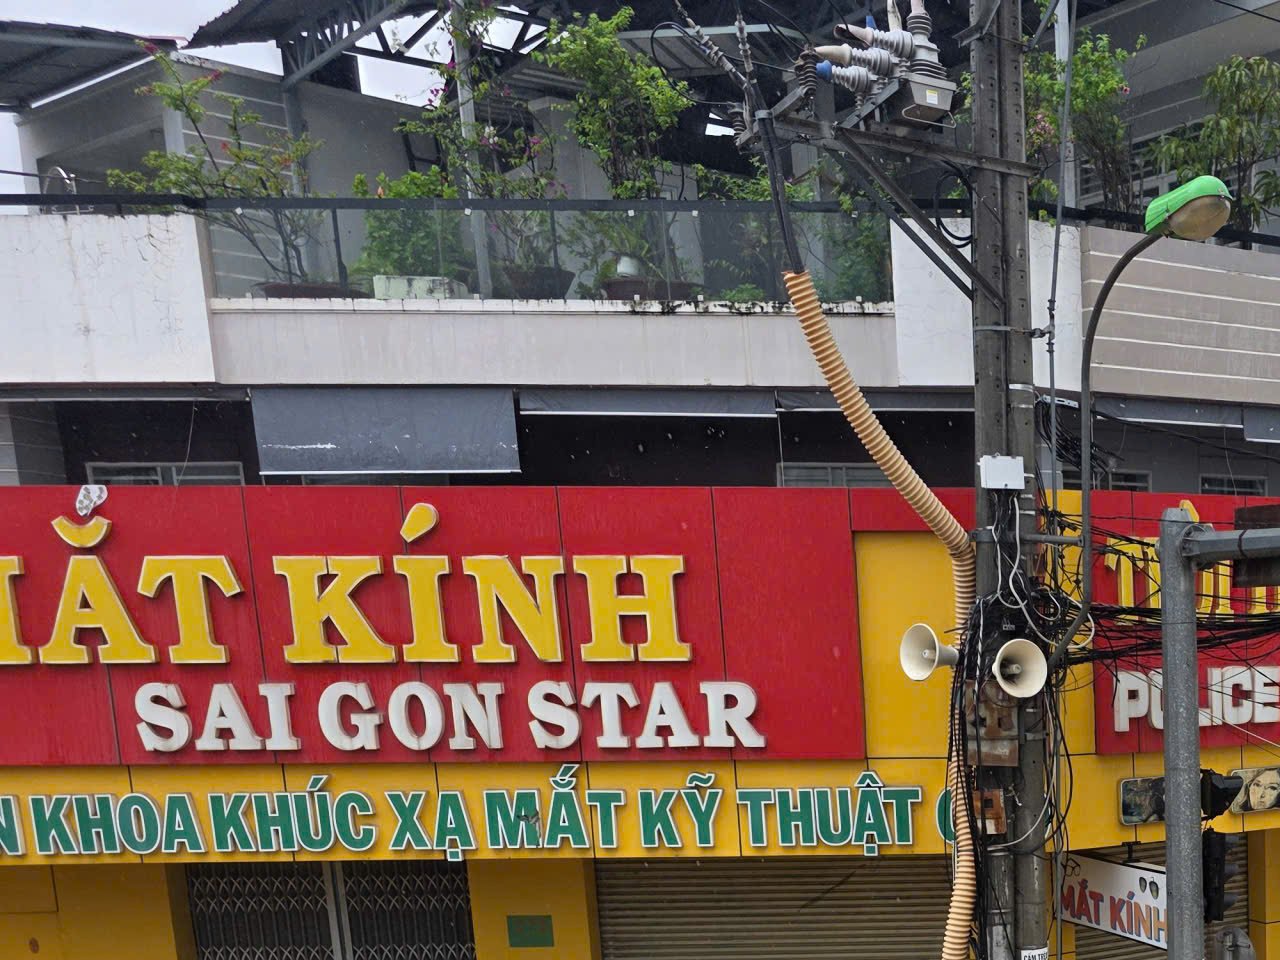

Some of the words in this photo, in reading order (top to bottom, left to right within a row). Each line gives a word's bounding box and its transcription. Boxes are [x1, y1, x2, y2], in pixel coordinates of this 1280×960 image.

[272, 502, 694, 665] KÍNH
[134, 681, 303, 753] SAI
[317, 680, 505, 752] GON
[528, 680, 767, 750] STAR
[29, 793, 207, 856] KHOA
[208, 774, 377, 853] KHÚC
[385, 790, 477, 861] XẠ
[484, 764, 627, 850] MẮT
[638, 772, 723, 848] KỸ
[736, 771, 922, 856] THUẬT
[1109, 890, 1168, 944] KÍNH
